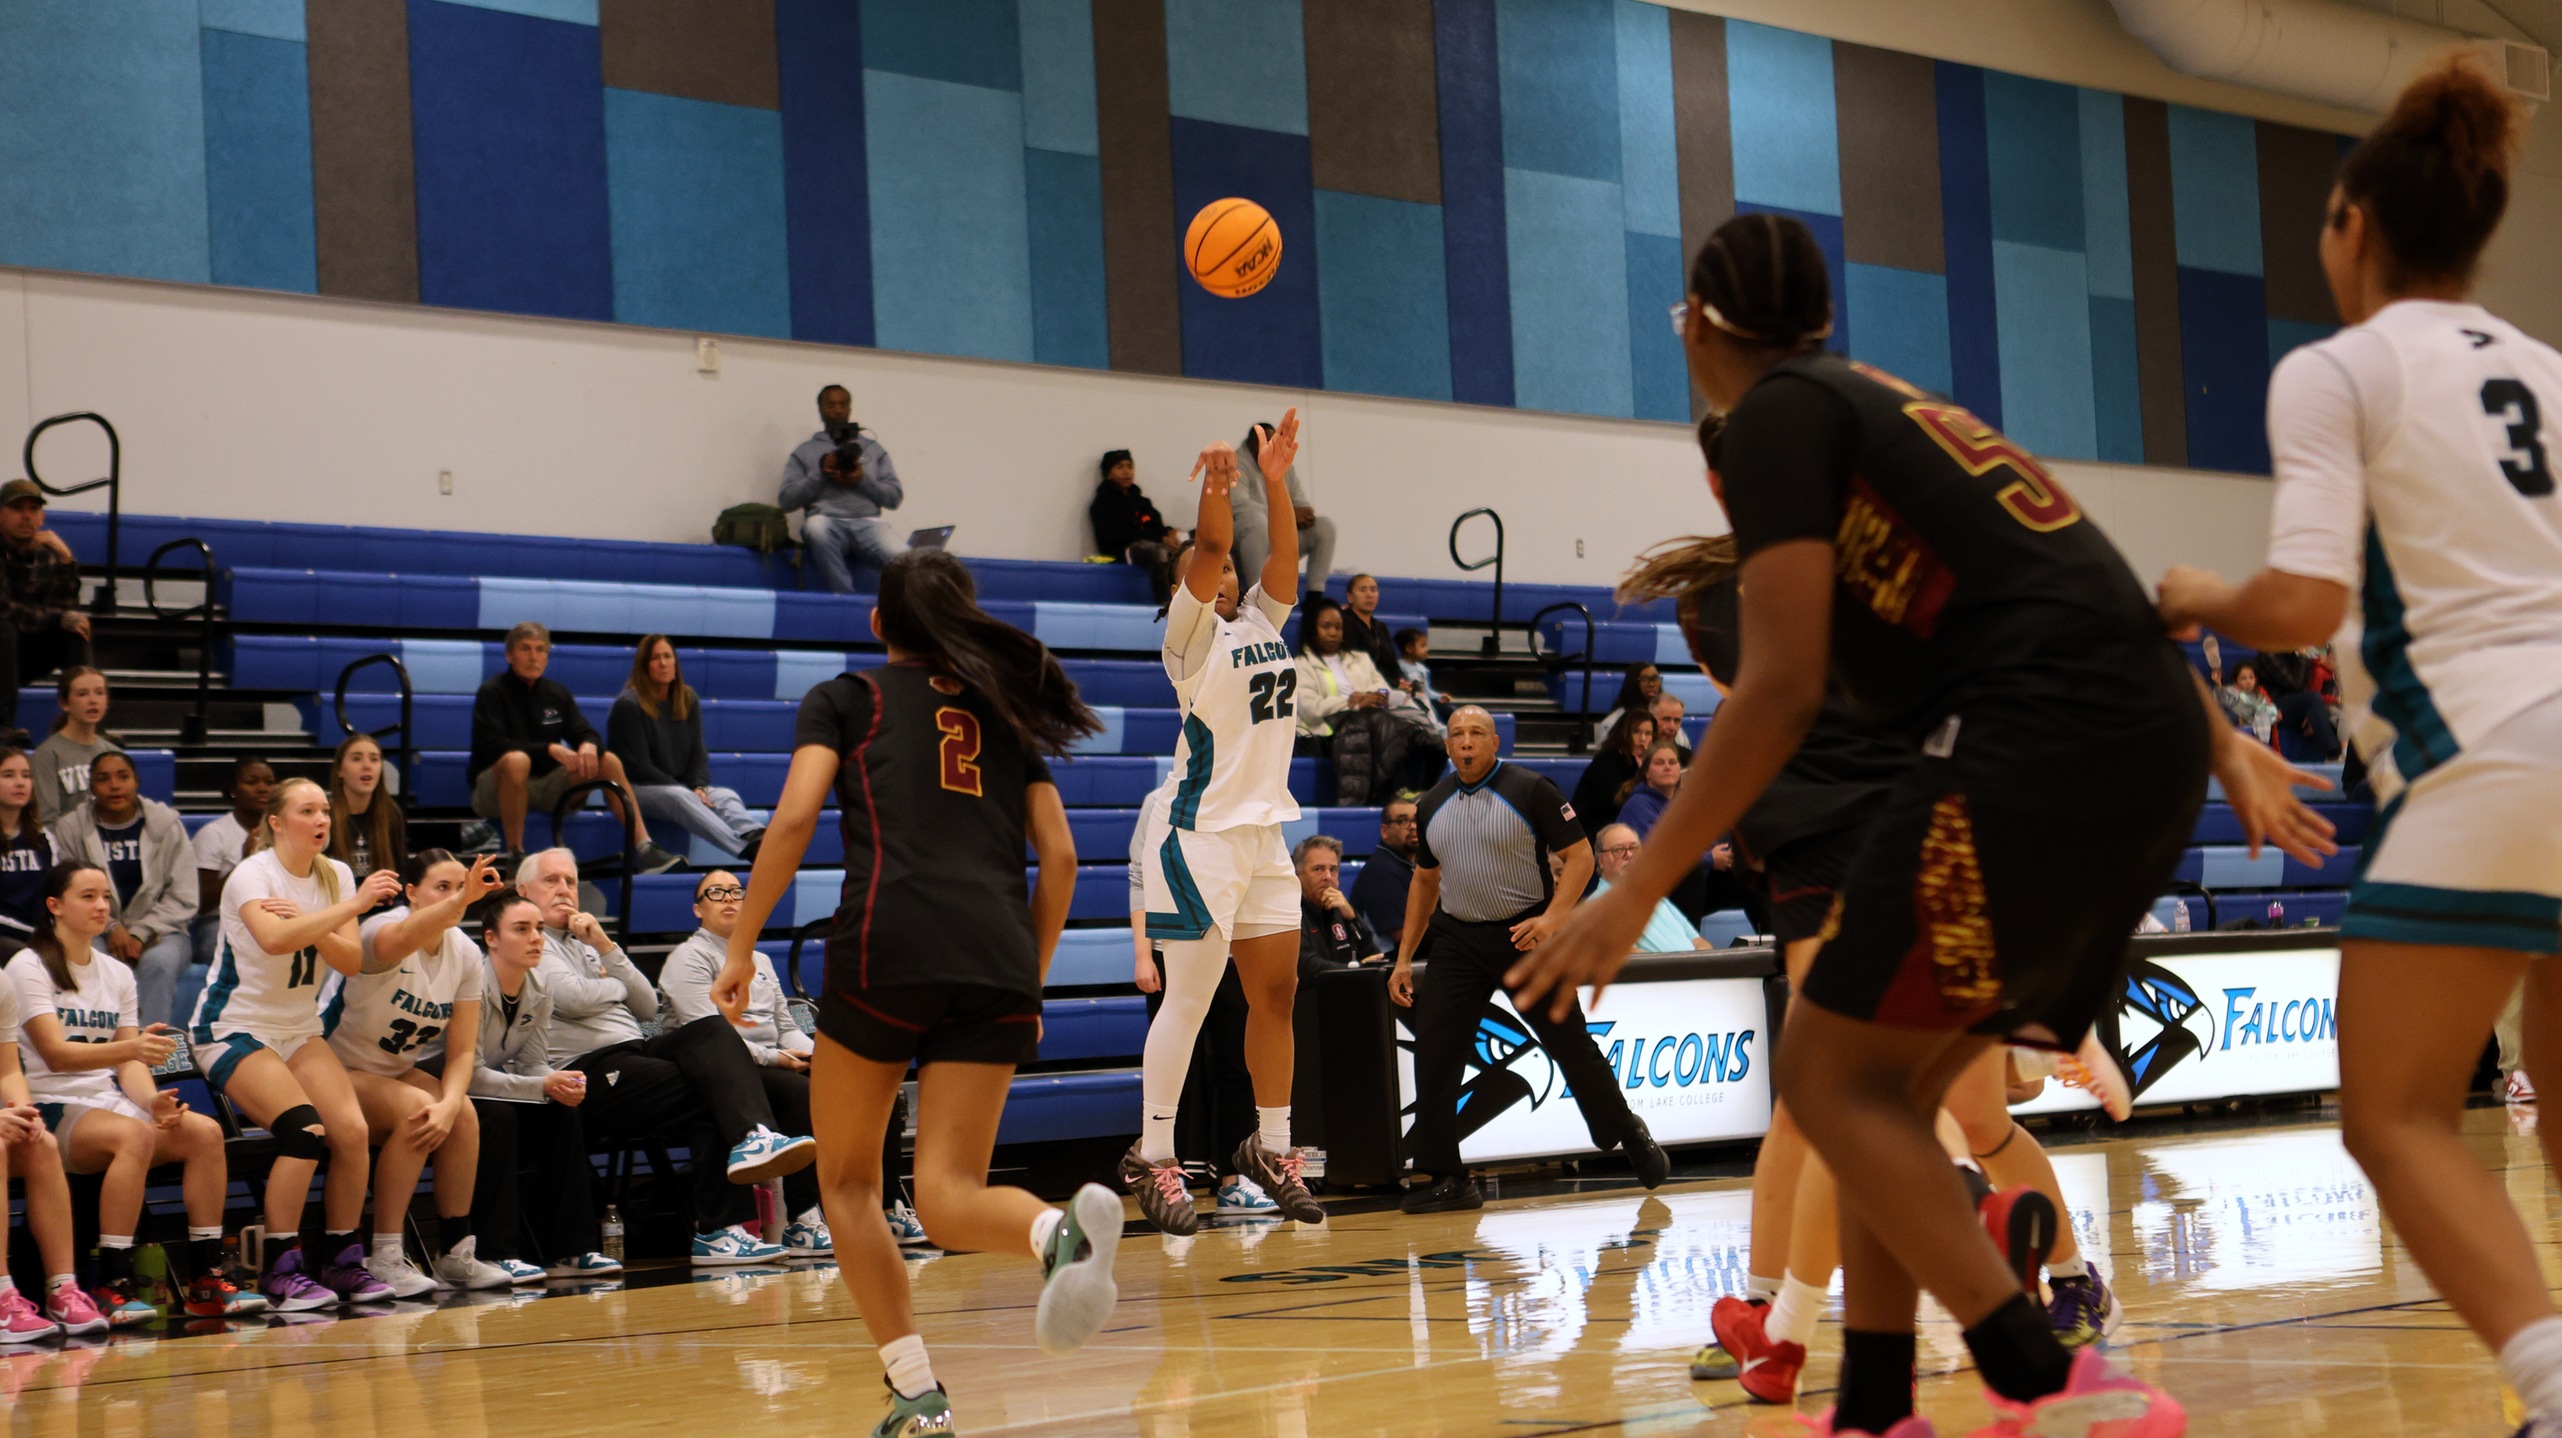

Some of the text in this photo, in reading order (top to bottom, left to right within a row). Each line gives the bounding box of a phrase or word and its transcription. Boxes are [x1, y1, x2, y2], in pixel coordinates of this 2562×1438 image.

[1902, 401, 2081, 531] 5
[2481, 379, 2554, 496] 3
[1231, 641, 1292, 668] FALCO
[1249, 668, 1297, 725] 22
[936, 706, 982, 796] 2
[288, 945, 317, 989] 11
[57, 1007, 119, 1030] FALCON
[2220, 987, 2338, 1051] FALCON
[1650, 1096, 1674, 1108] LAKE
[1679, 1092, 1724, 1106] COLLEGE
